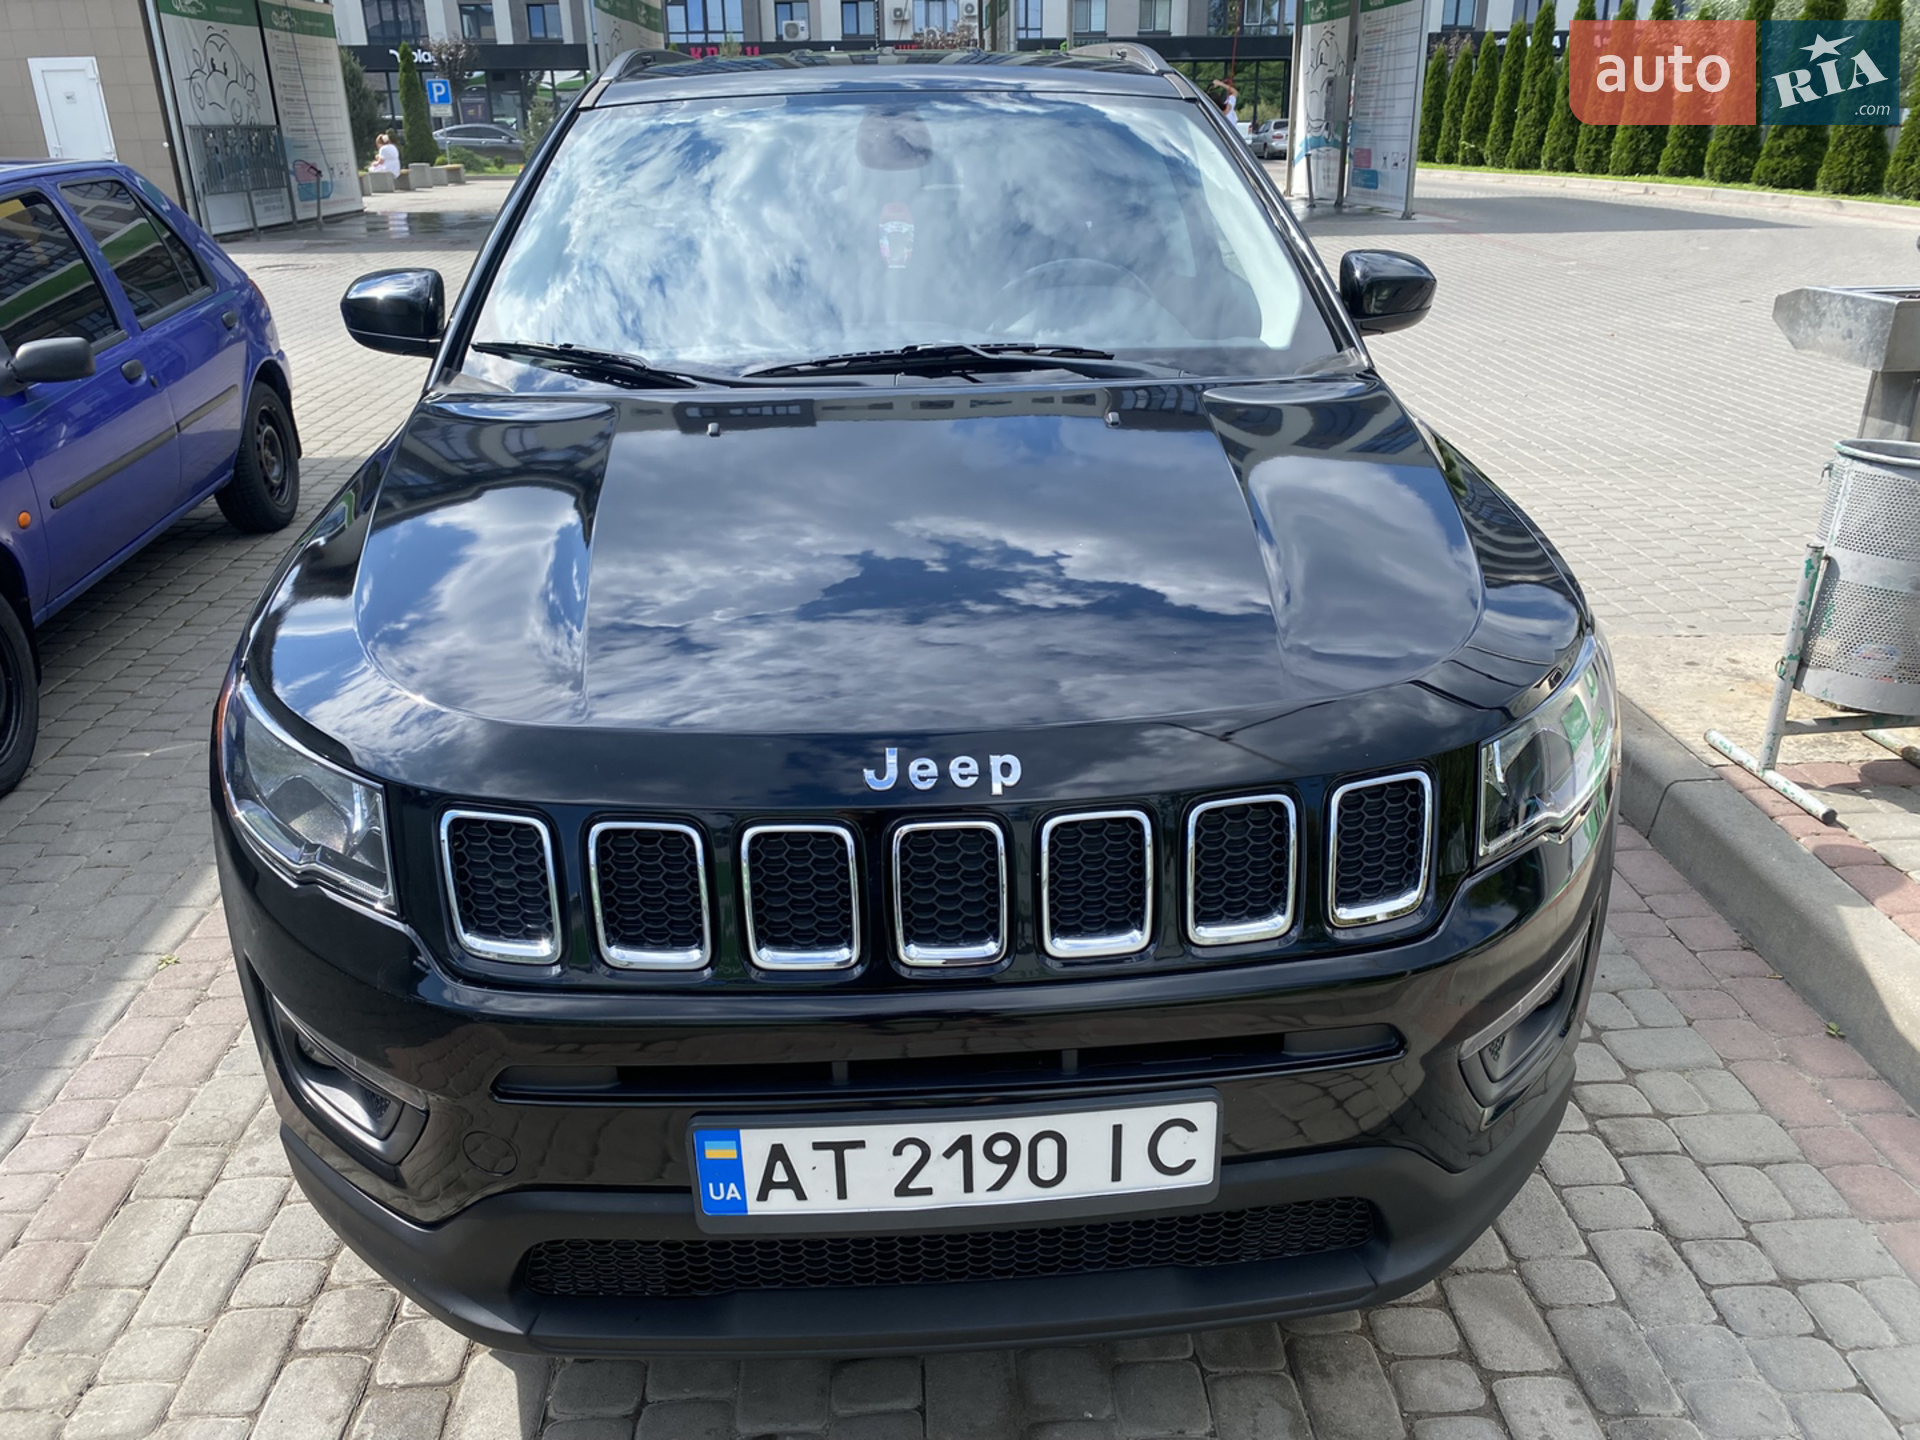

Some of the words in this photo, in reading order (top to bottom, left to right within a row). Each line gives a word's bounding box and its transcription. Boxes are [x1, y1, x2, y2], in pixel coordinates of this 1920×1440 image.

[432, 82, 446, 103] P
[863, 747, 1022, 796] Jeep
[756, 1140, 866, 1202] AT
[893, 1130, 1067, 1197] 2190
[1110, 1118, 1199, 1183] IC
[709, 1182, 742, 1201] UA
